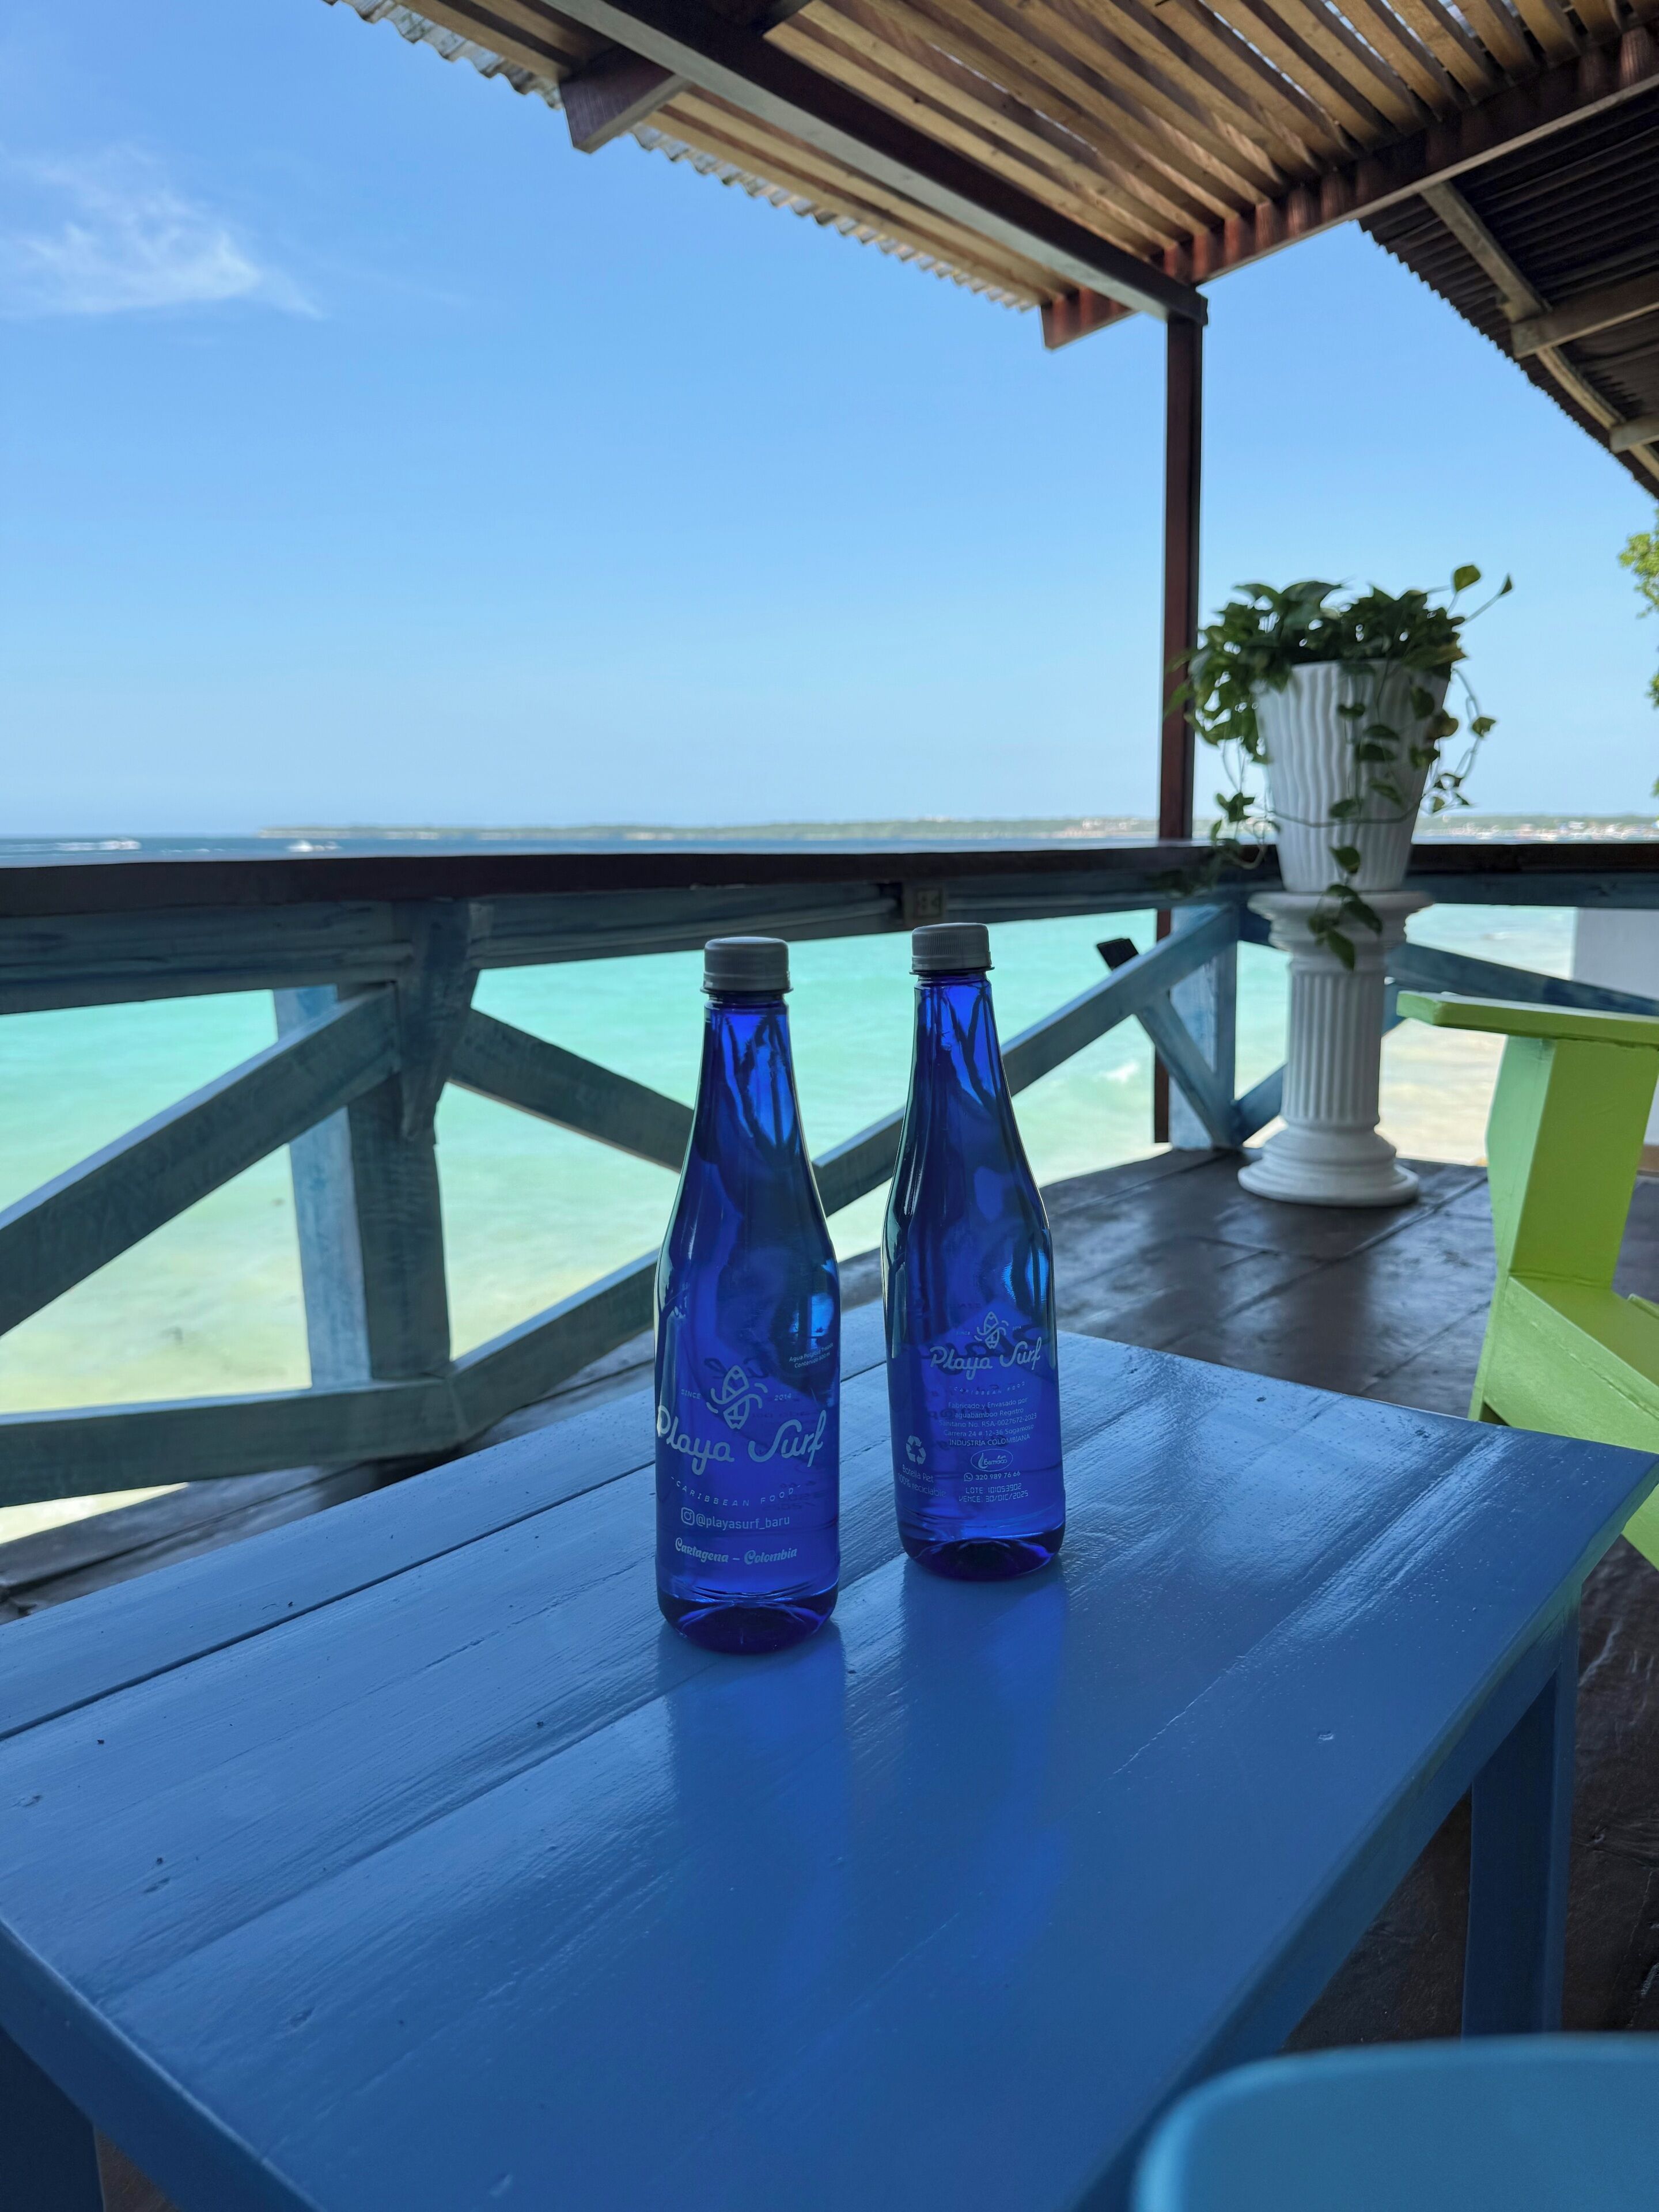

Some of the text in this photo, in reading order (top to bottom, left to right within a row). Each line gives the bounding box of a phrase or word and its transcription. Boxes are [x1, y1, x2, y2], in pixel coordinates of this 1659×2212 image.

[929, 1336, 1042, 1380] Playa Surf
[680, 1389, 792, 1402] SINCE 2014
[948, 1402, 980, 1410] Fabricado
[987, 1399, 1017, 1408] Envasado
[1018, 1397, 1028, 1406] por
[955, 1411, 998, 1420] aguabamboo
[999, 1408, 1024, 1417] Registro
[944, 1429, 967, 1437] Carrera
[1005, 1424, 1035, 1435] Sogamoso
[656, 1405, 827, 1475] Playa Surf
[949, 1438, 986, 1446] INDUSTRIA
[987, 1434, 1031, 1446] COLOMBIANA
[902, 1464, 934, 1483] Botella Pet
[912, 1483, 946, 1498] reciclable
[695, 1513, 790, 1531] @playasurf_baru
[675, 1537, 729, 1563] Cartagena
[744, 1547, 798, 1565] Colombia
